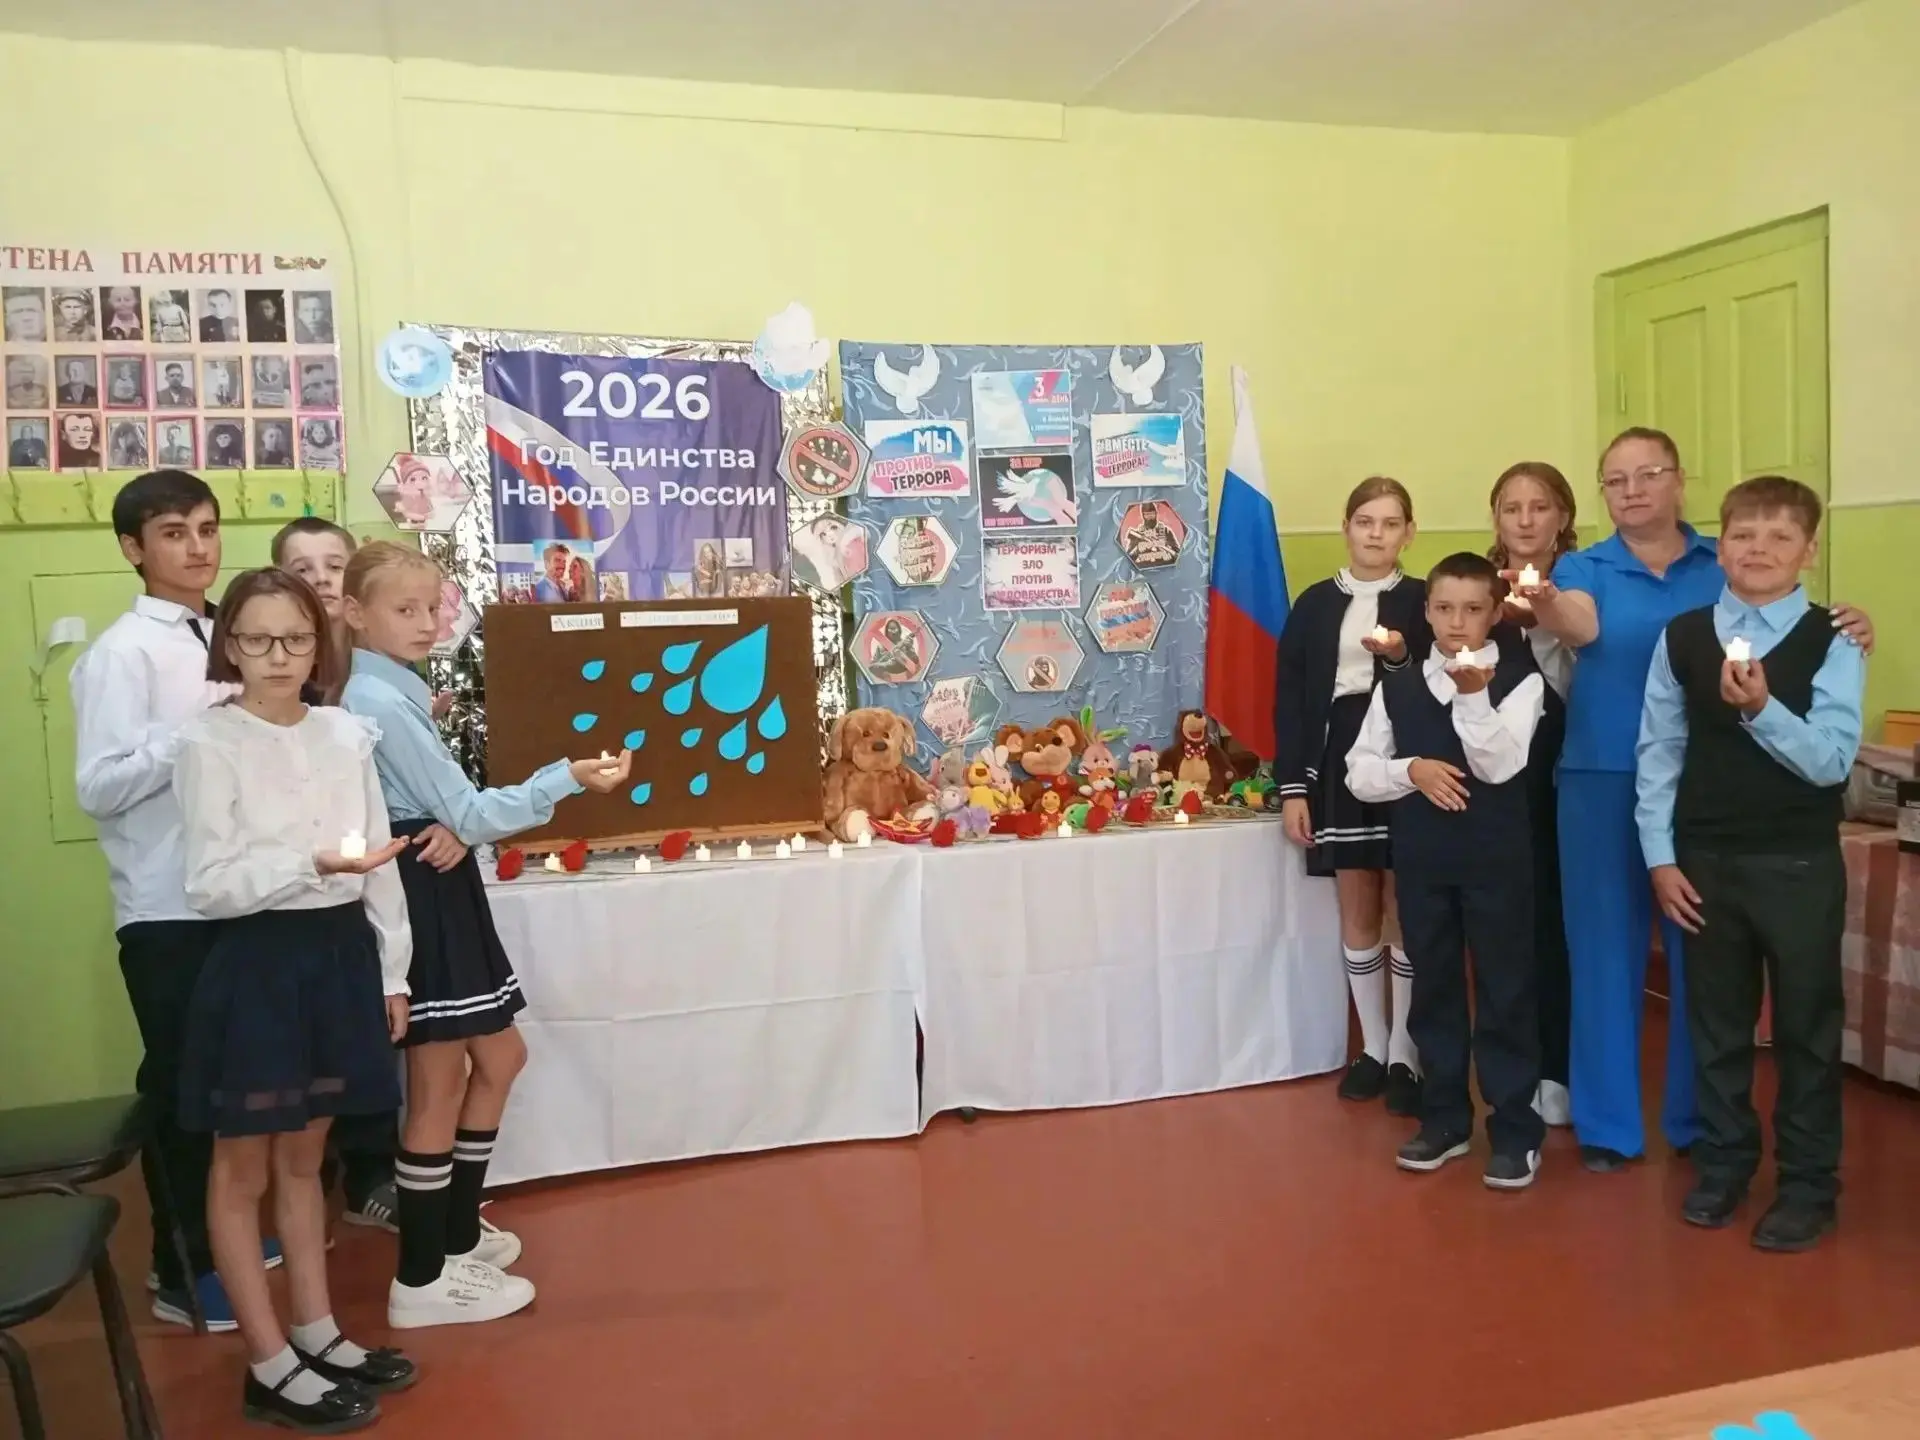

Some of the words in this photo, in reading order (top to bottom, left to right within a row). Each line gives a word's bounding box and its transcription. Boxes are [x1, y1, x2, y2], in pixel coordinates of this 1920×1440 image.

[0, 246, 94, 272] ТЕНА
[121, 252, 263, 275] ПАМЯТИ
[559, 371, 711, 420] 2026
[1034, 376, 1044, 397] 3
[913, 430, 952, 453] МЫ
[520, 439, 577, 468] Год
[589, 441, 756, 471] Единства
[875, 456, 933, 476] ПРОТИВ
[891, 470, 952, 490] ТЕРРОРА
[502, 479, 649, 511] Народов
[659, 481, 776, 506] России
[997, 544, 1056, 555] ТЕРРОРИЗМ
[1022, 560, 1043, 569] ЗЛО
[1012, 575, 1052, 584] ПРОТИВ
